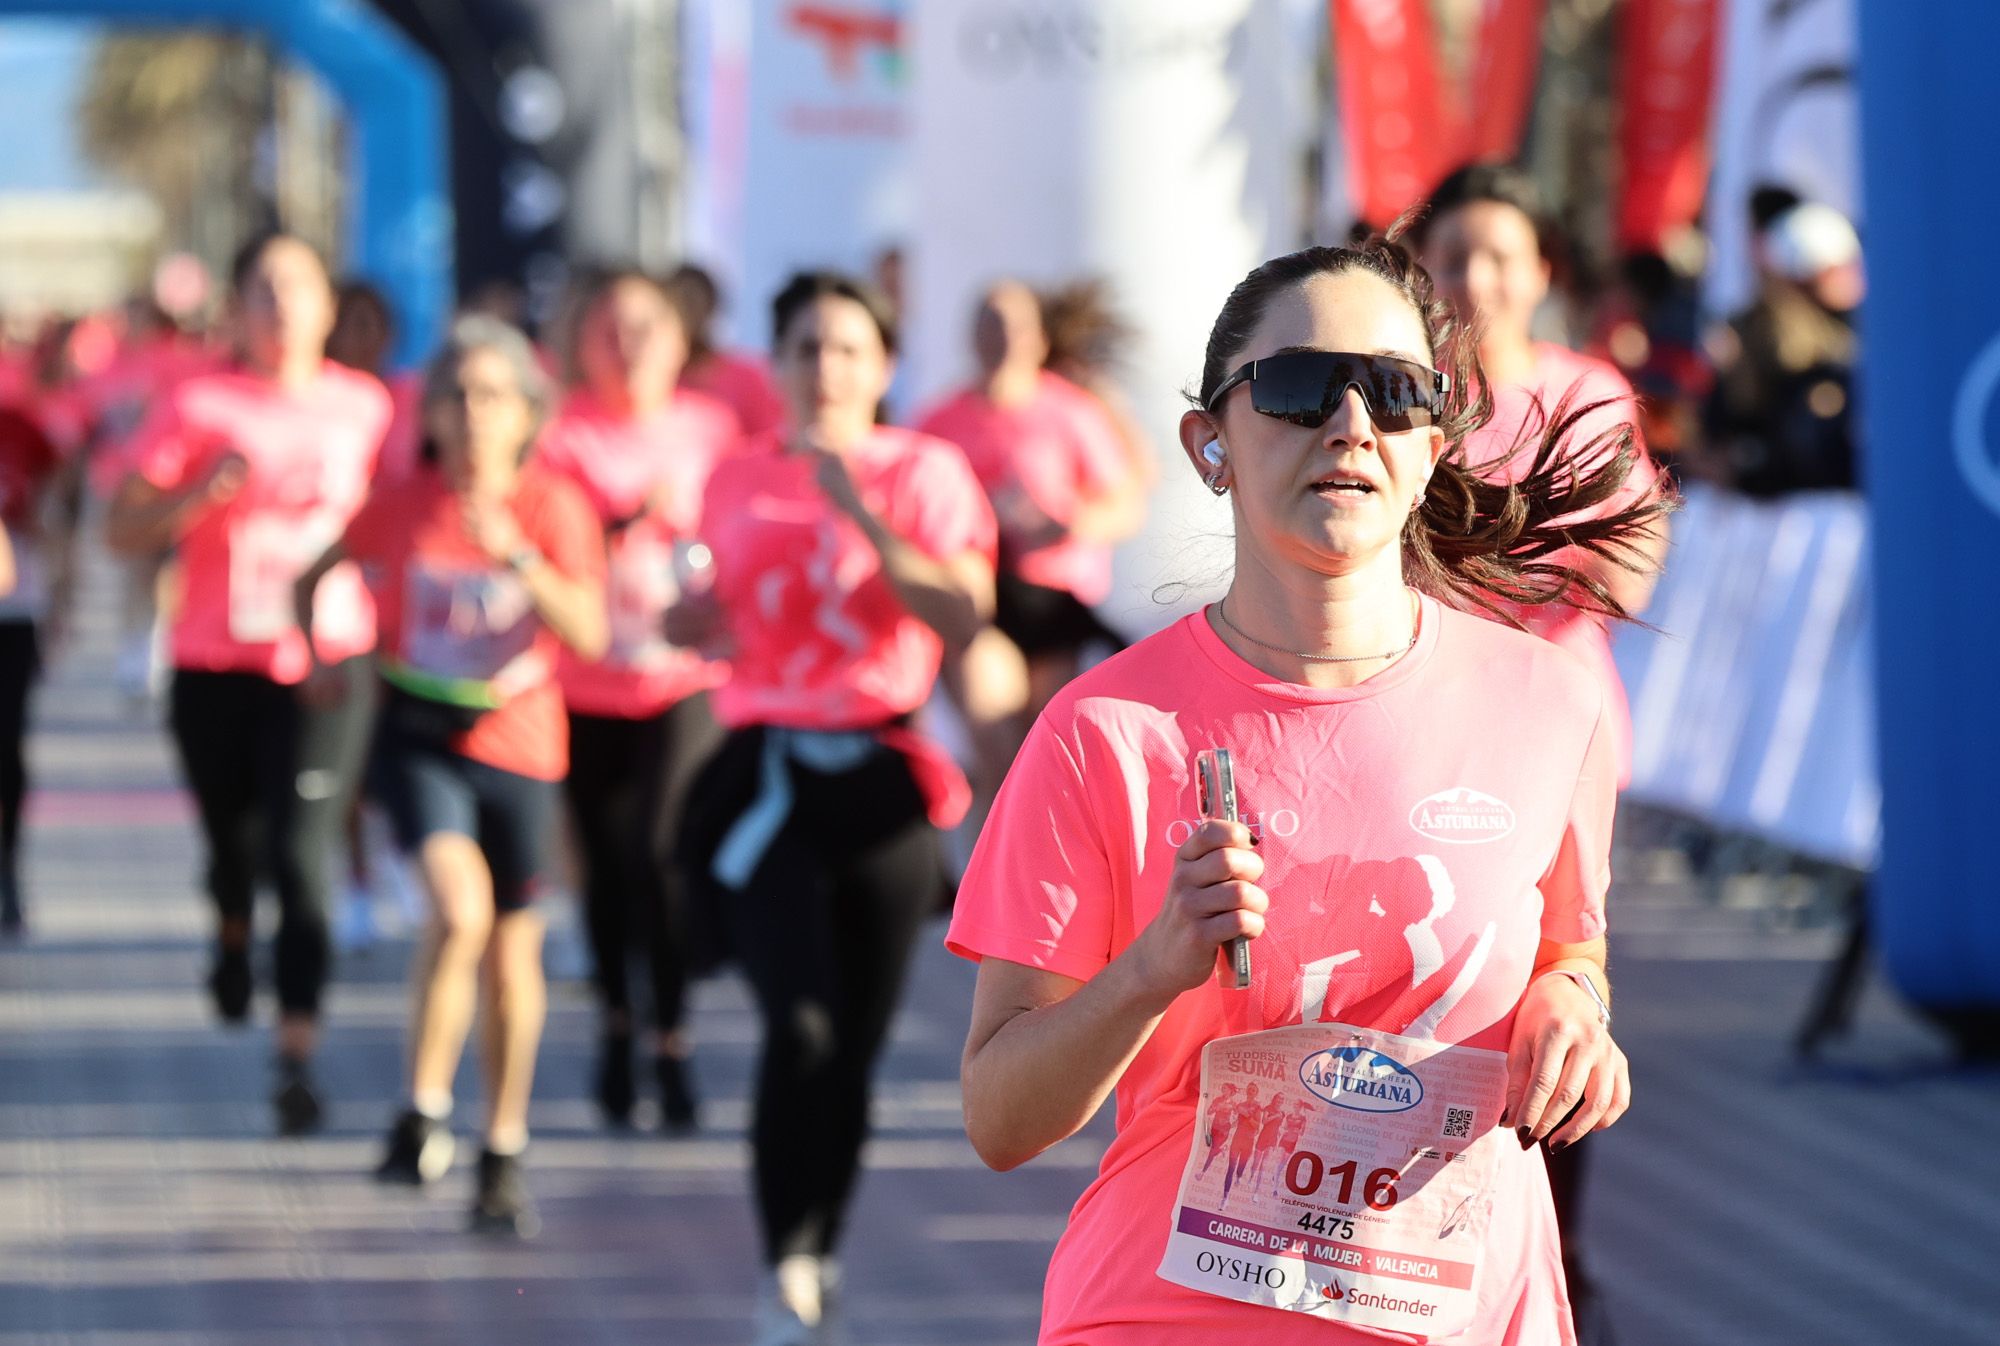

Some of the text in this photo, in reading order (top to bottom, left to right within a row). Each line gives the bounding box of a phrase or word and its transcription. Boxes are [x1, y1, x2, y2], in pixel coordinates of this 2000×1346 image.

[1165, 809, 1300, 848] OHO
[1225, 1051, 1288, 1065] TU DORSAL
[1228, 1059, 1287, 1082] SUMA
[1306, 1061, 1413, 1104] ASTURIANA
[1285, 1150, 1401, 1211] 016
[1281, 1198, 1316, 1210] TELÉFONO
[1317, 1206, 1352, 1218] VIOLENCIA
[1297, 1211, 1355, 1240] 4475
[1208, 1220, 1439, 1280] CARRERA DE LA MUJER VALENCIA
[1196, 1251, 1286, 1289] OYSHO
[1346, 1287, 1438, 1317] Santander
